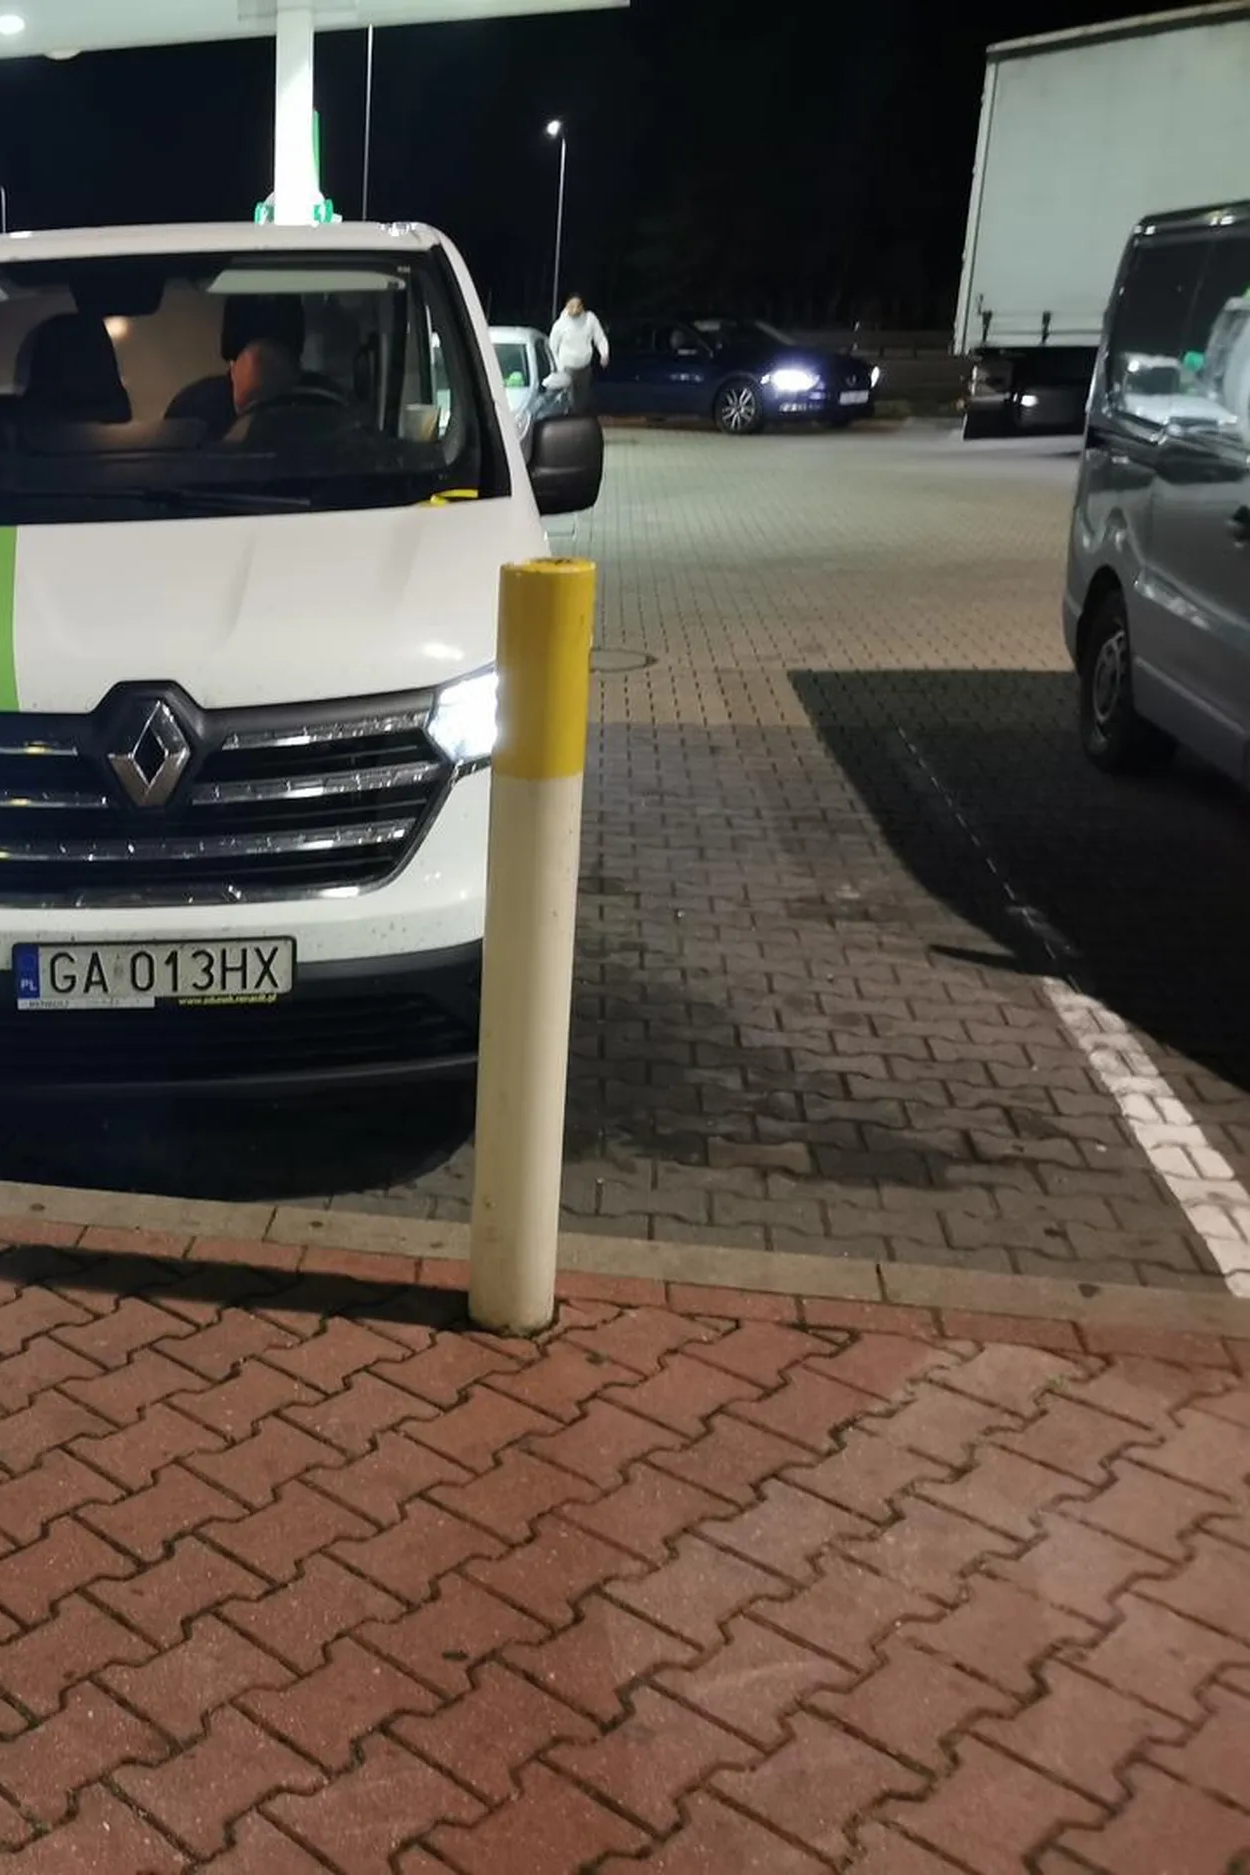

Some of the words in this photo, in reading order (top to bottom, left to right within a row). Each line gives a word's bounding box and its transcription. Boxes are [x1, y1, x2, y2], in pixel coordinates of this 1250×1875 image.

[20, 979, 38, 991] PL
[50, 951, 108, 994] GA
[129, 946, 280, 993] 013HX
